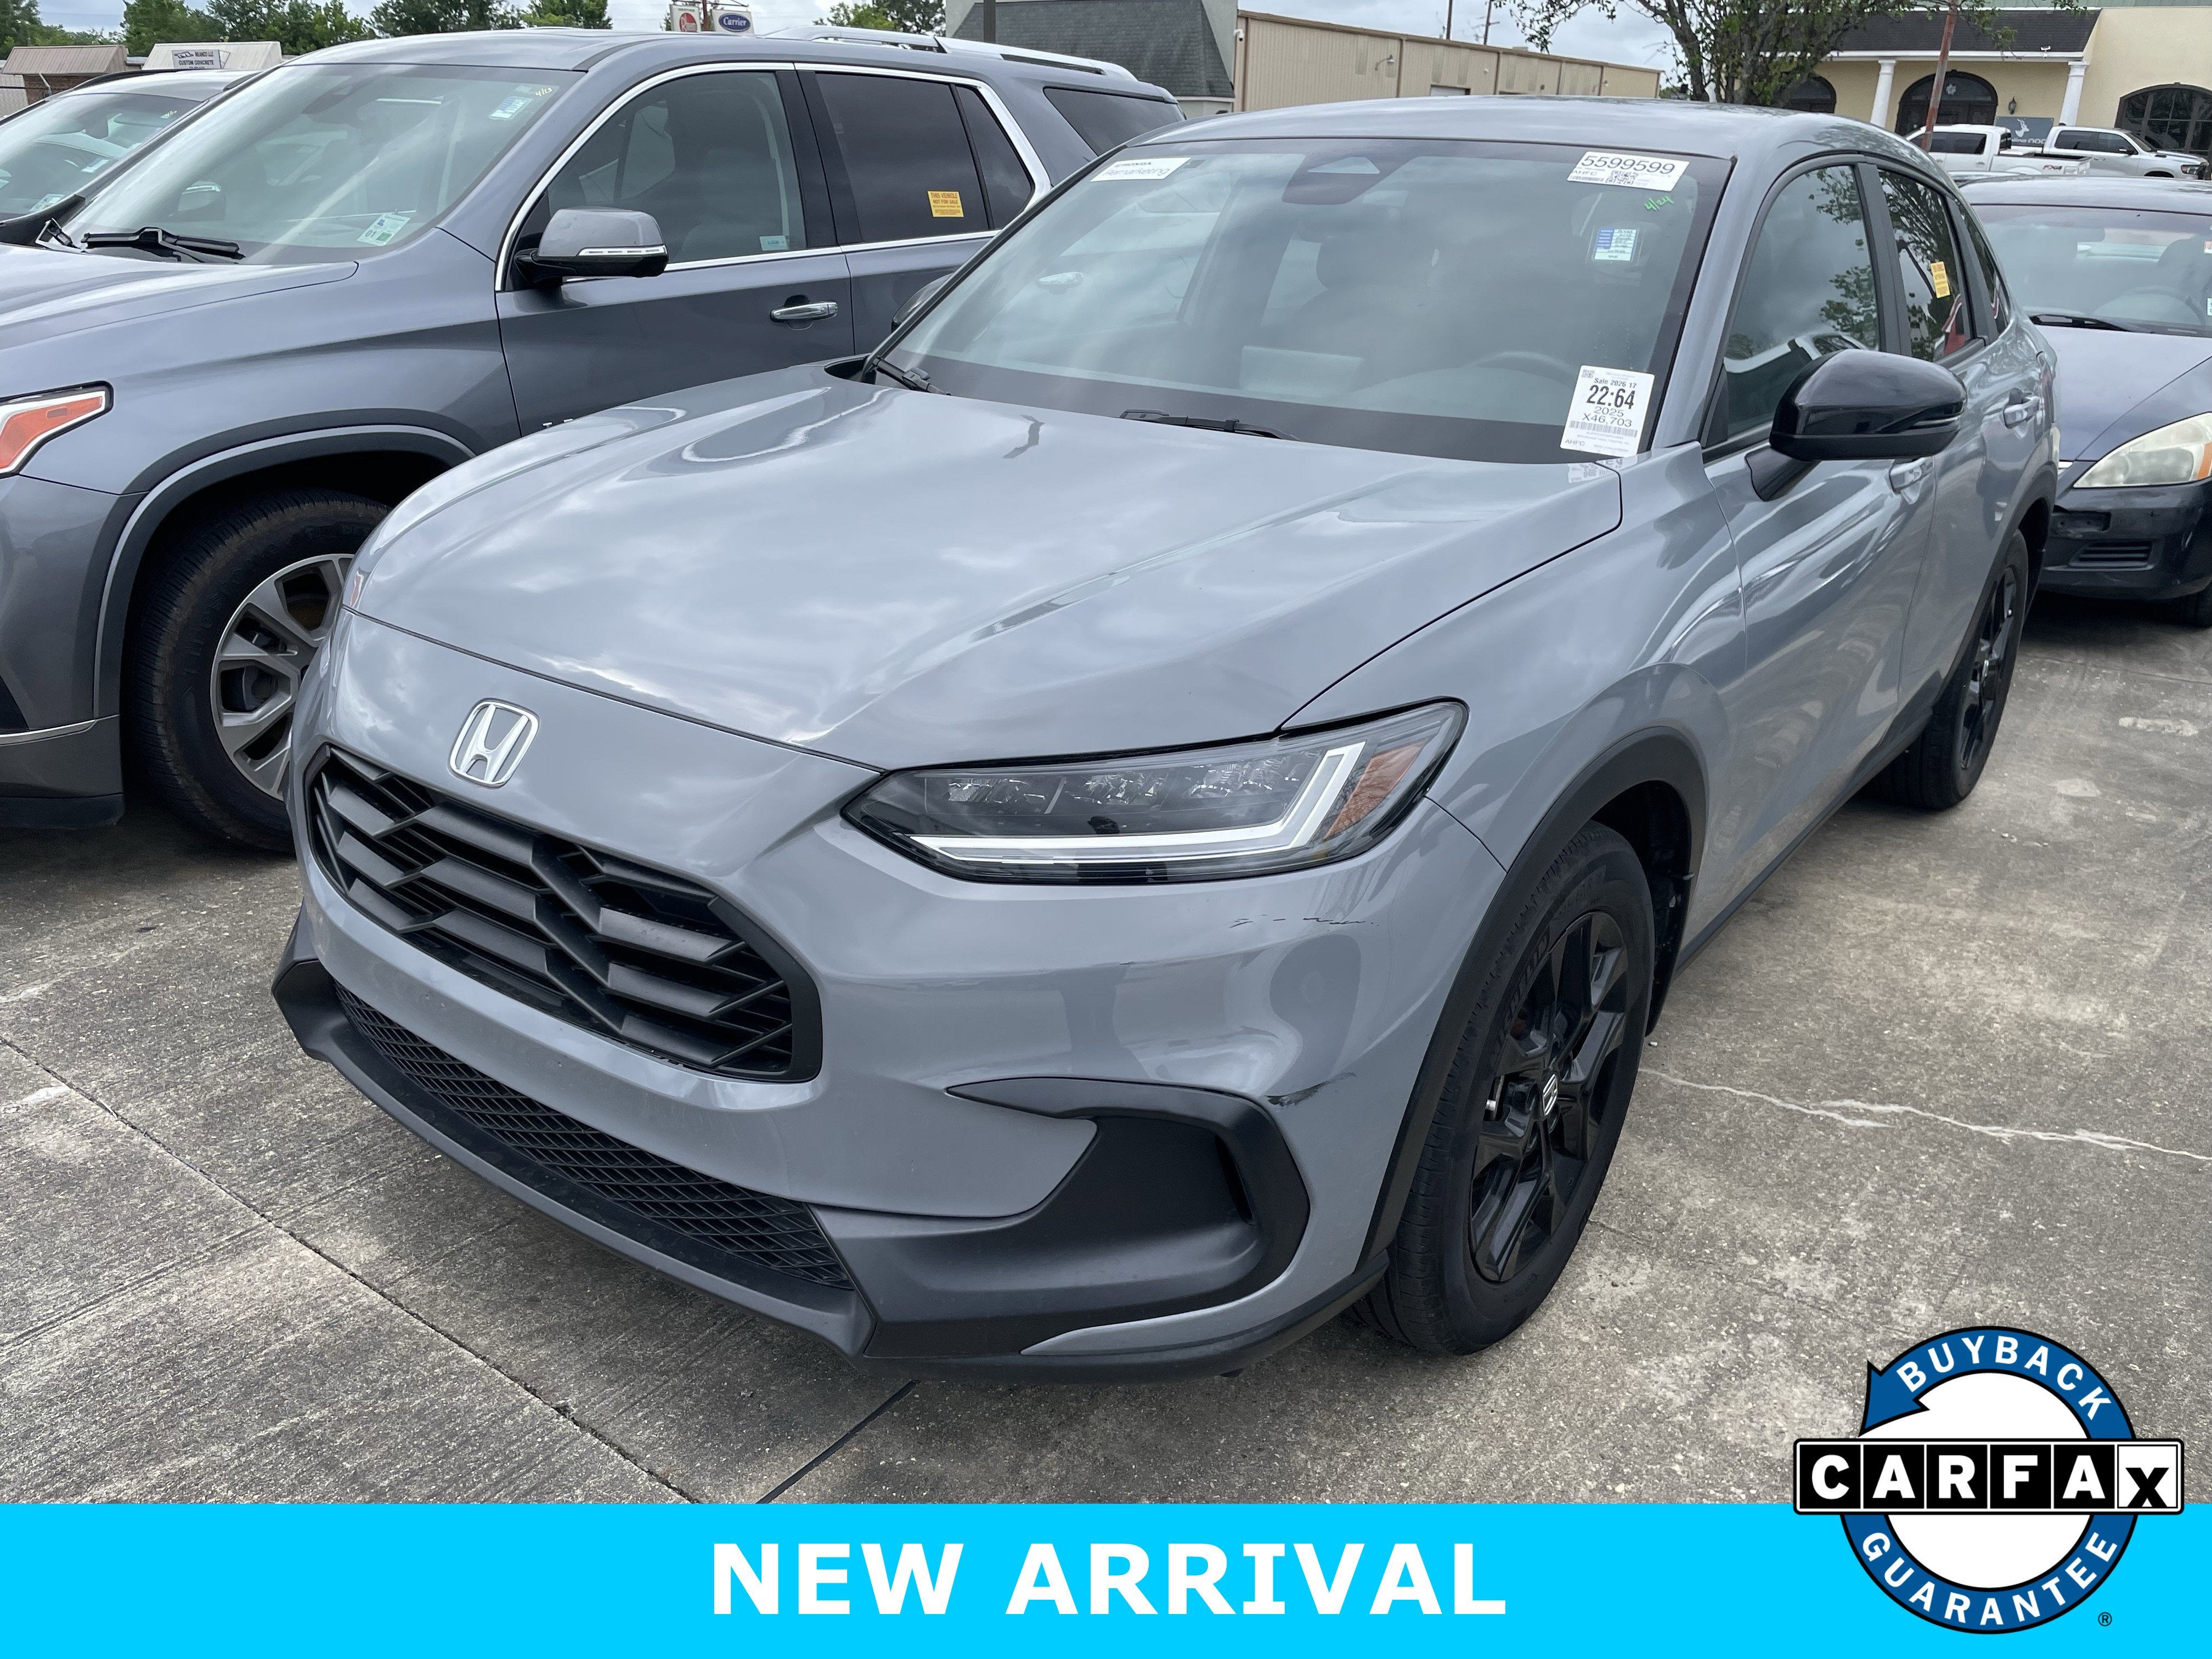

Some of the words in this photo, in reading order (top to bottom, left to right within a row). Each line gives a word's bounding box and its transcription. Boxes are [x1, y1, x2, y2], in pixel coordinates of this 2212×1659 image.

[723, 17, 746, 26] Carrier
[1582, 156, 1675, 174] 5599599
[1587, 385, 1635, 409] 22:64
[1594, 406, 1624, 417] 2025
[1582, 413, 1632, 427] X46,703
